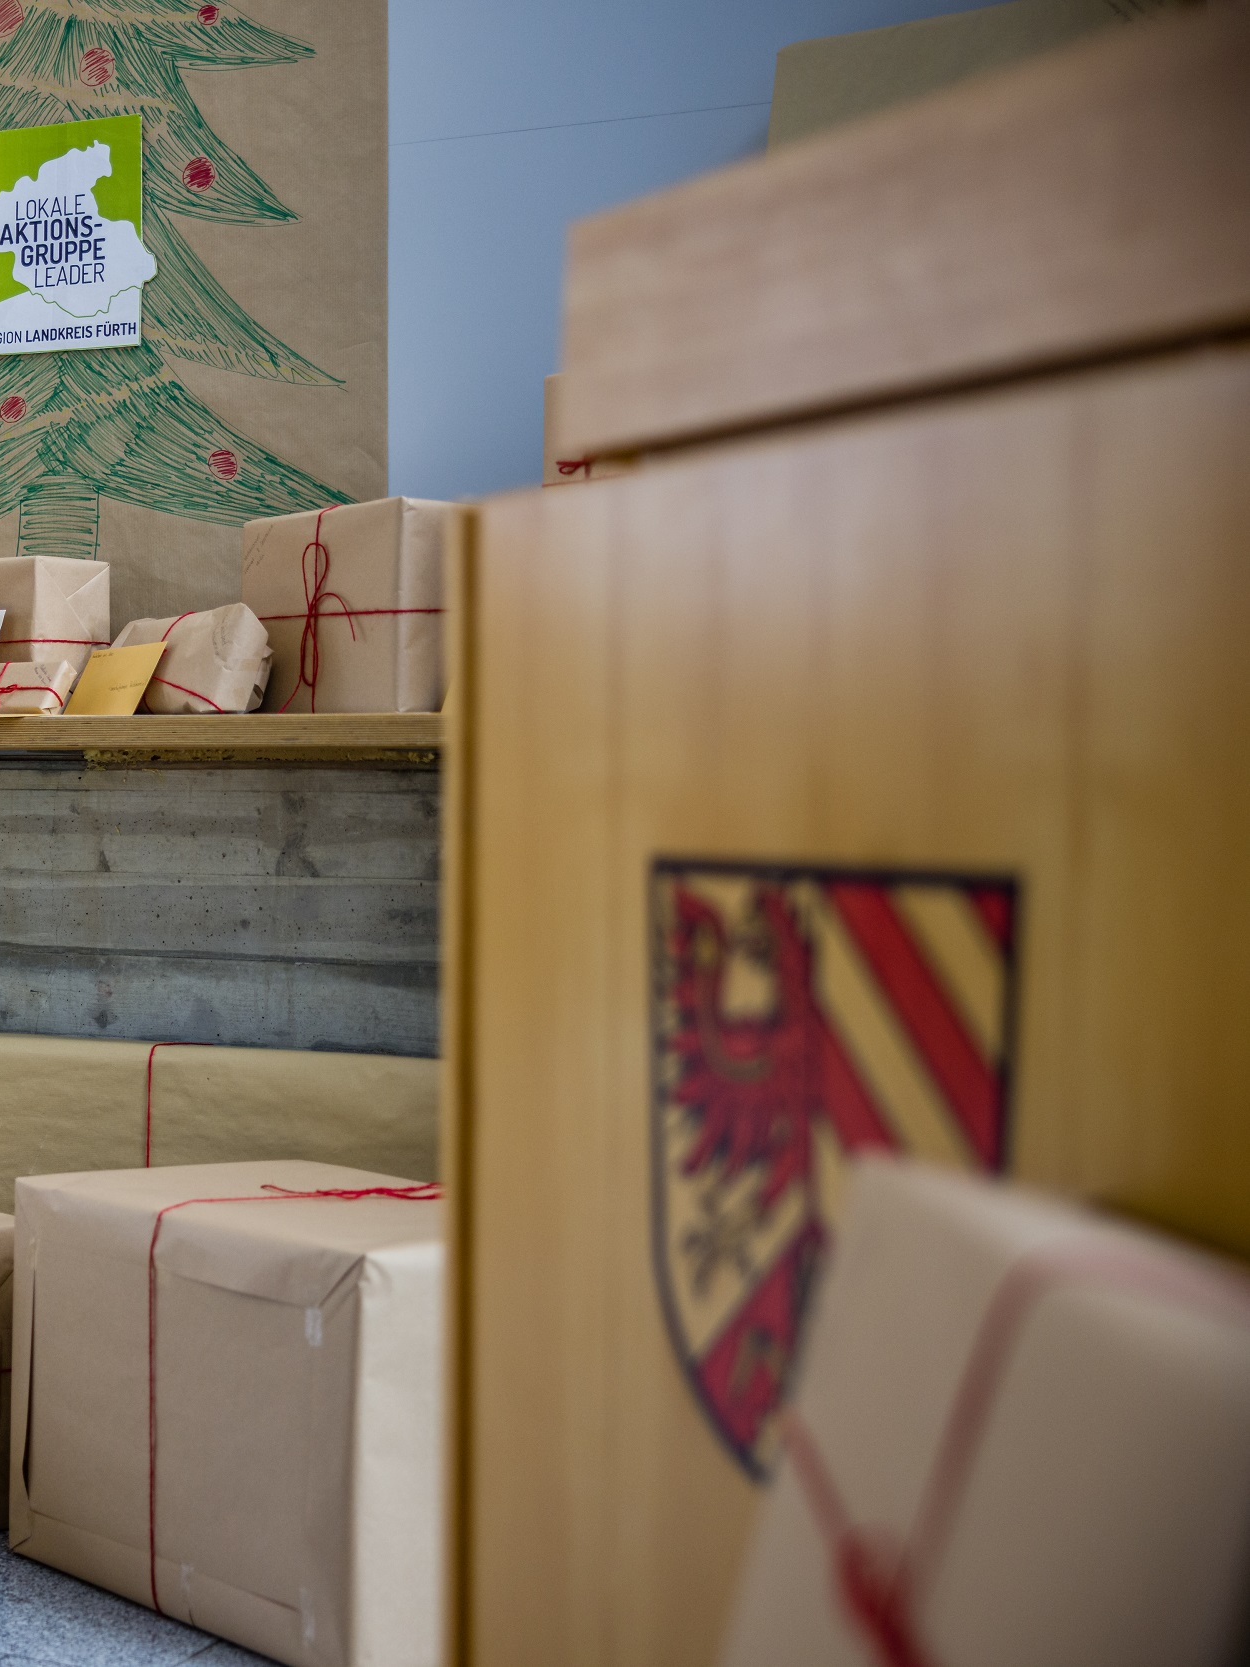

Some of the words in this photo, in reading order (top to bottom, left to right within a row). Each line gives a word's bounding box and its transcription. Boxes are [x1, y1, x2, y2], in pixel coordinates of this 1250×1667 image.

[15, 194, 86, 221] LOKALE
[0, 215, 103, 246] AKTIONS-
[21, 238, 105, 267] GRUPPE
[34, 262, 105, 288] LEADER
[25, 324, 93, 343] LANDKREIS
[96, 321, 137, 338] FÜRTH
